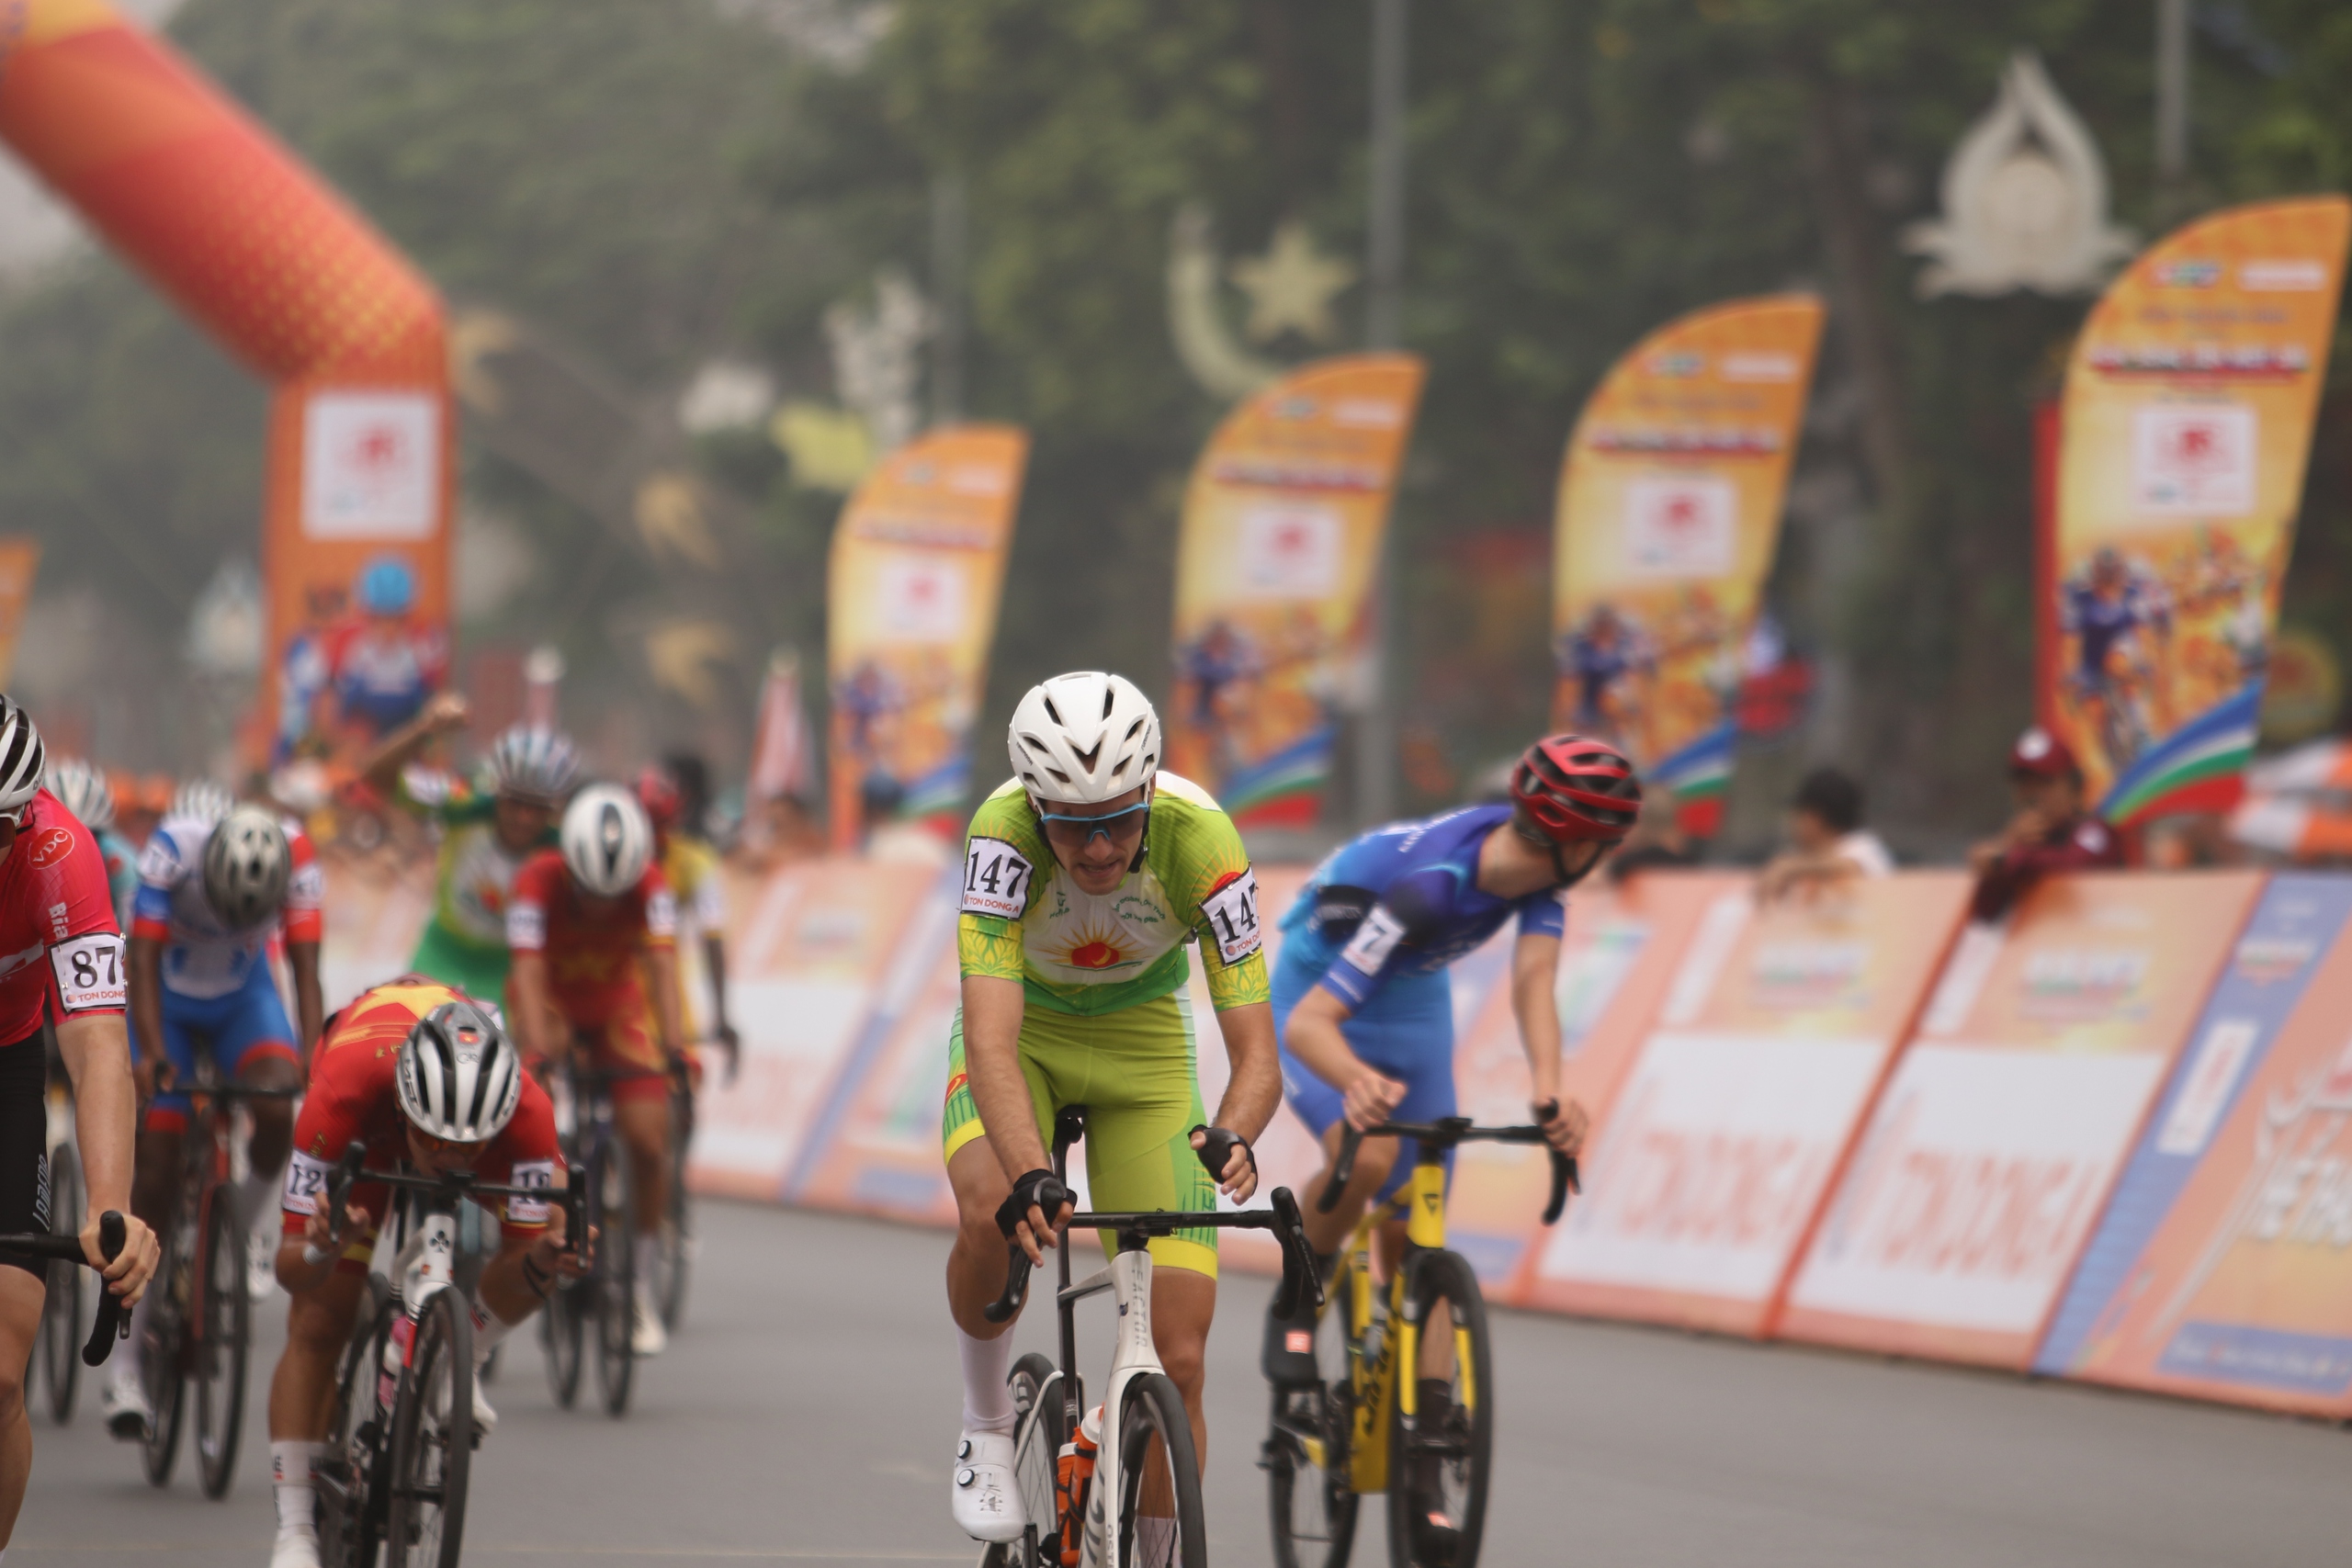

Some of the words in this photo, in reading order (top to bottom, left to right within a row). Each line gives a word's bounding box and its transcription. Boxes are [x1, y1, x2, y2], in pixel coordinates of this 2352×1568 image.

[33, 830, 68, 863] VDC
[967, 851, 1028, 898] 147
[49, 902, 69, 939] Bia
[969, 897, 984, 905] TON
[984, 898, 1012, 912] DONG
[1012, 905, 1020, 913] A
[1237, 939, 1252, 952] TON
[72, 945, 117, 988] 87
[78, 991, 99, 1001] TON
[1131, 1269, 1148, 1348] FACTOR
